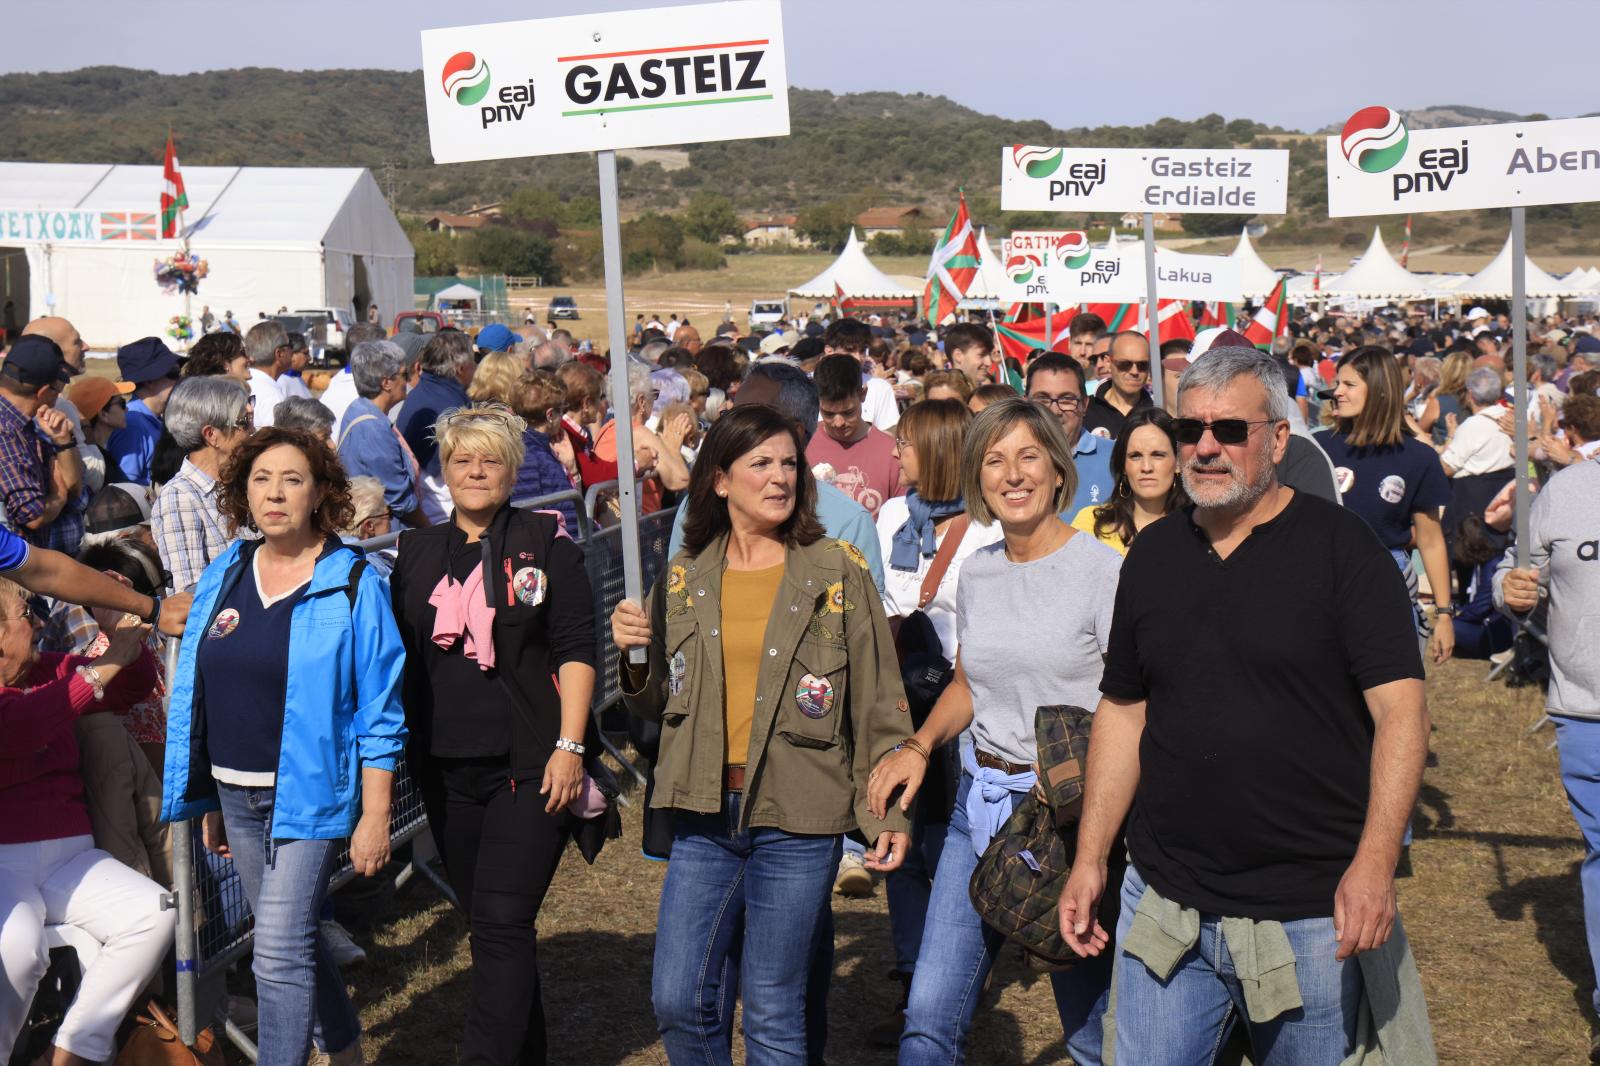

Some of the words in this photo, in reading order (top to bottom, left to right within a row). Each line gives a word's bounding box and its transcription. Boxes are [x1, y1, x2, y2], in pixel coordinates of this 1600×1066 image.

[565, 50, 766, 105] GASTEIZ
[498, 79, 536, 107] eaj
[481, 104, 526, 129] pnv
[1151, 156, 1252, 178] Gasteiz
[1418, 139, 1468, 175] eaj
[1506, 146, 1600, 176] Aben
[1069, 158, 1106, 185] eaj
[1049, 180, 1095, 201] pnv
[1144, 186, 1256, 207] Erdialde
[1393, 171, 1456, 201] pnv
[1080, 271, 1113, 287] pnv
[1095, 258, 1121, 276] eaj
[1157, 266, 1212, 284] Lakua
